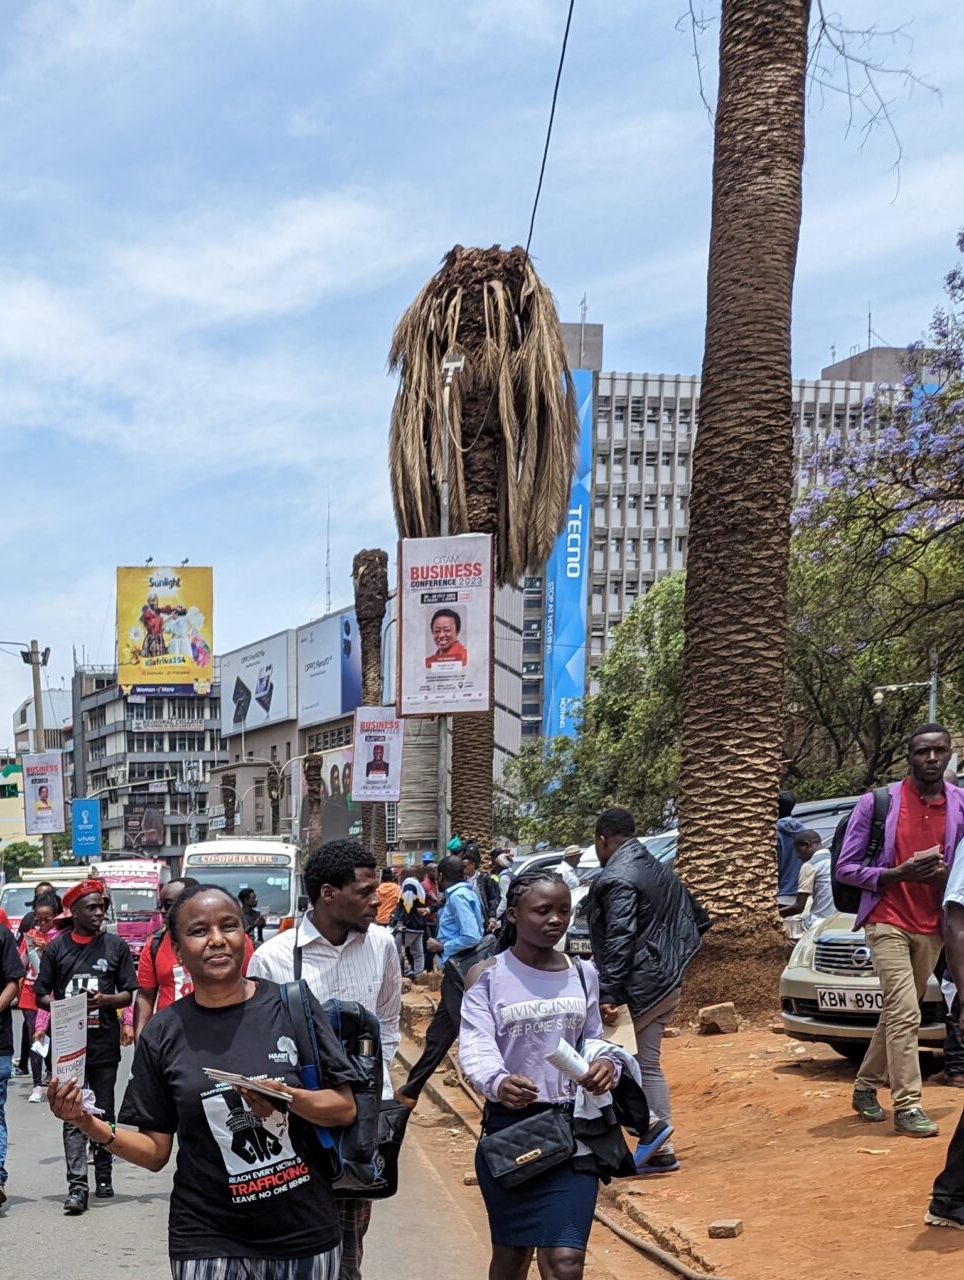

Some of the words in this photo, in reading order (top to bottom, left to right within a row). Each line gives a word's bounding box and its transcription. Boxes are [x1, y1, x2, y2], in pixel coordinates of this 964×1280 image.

[566, 504, 583, 578] TECNO
[410, 562, 482, 580] BUSINESS
[148, 577, 181, 590] Sunlight
[410, 580, 456, 588] CONFERENCE
[459, 577, 482, 586] 2023
[360, 721, 399, 729] BUSINESS
[26, 765, 58, 774] BUSINESS
[202, 855, 272, 863] CO-OPERATOR
[819, 991, 847, 1008] KBW
[228, 1173, 252, 1184] REACH
[252, 1167, 275, 1179] EVERY
[276, 1160, 296, 1172] VICTIM
[229, 1162, 309, 1196] TRAFFICKING
[232, 1194, 257, 1203] LEAVE
[258, 1190, 272, 1200] NO
[273, 1185, 289, 1195] ONE
[288, 1174, 311, 1189] BEHIND
